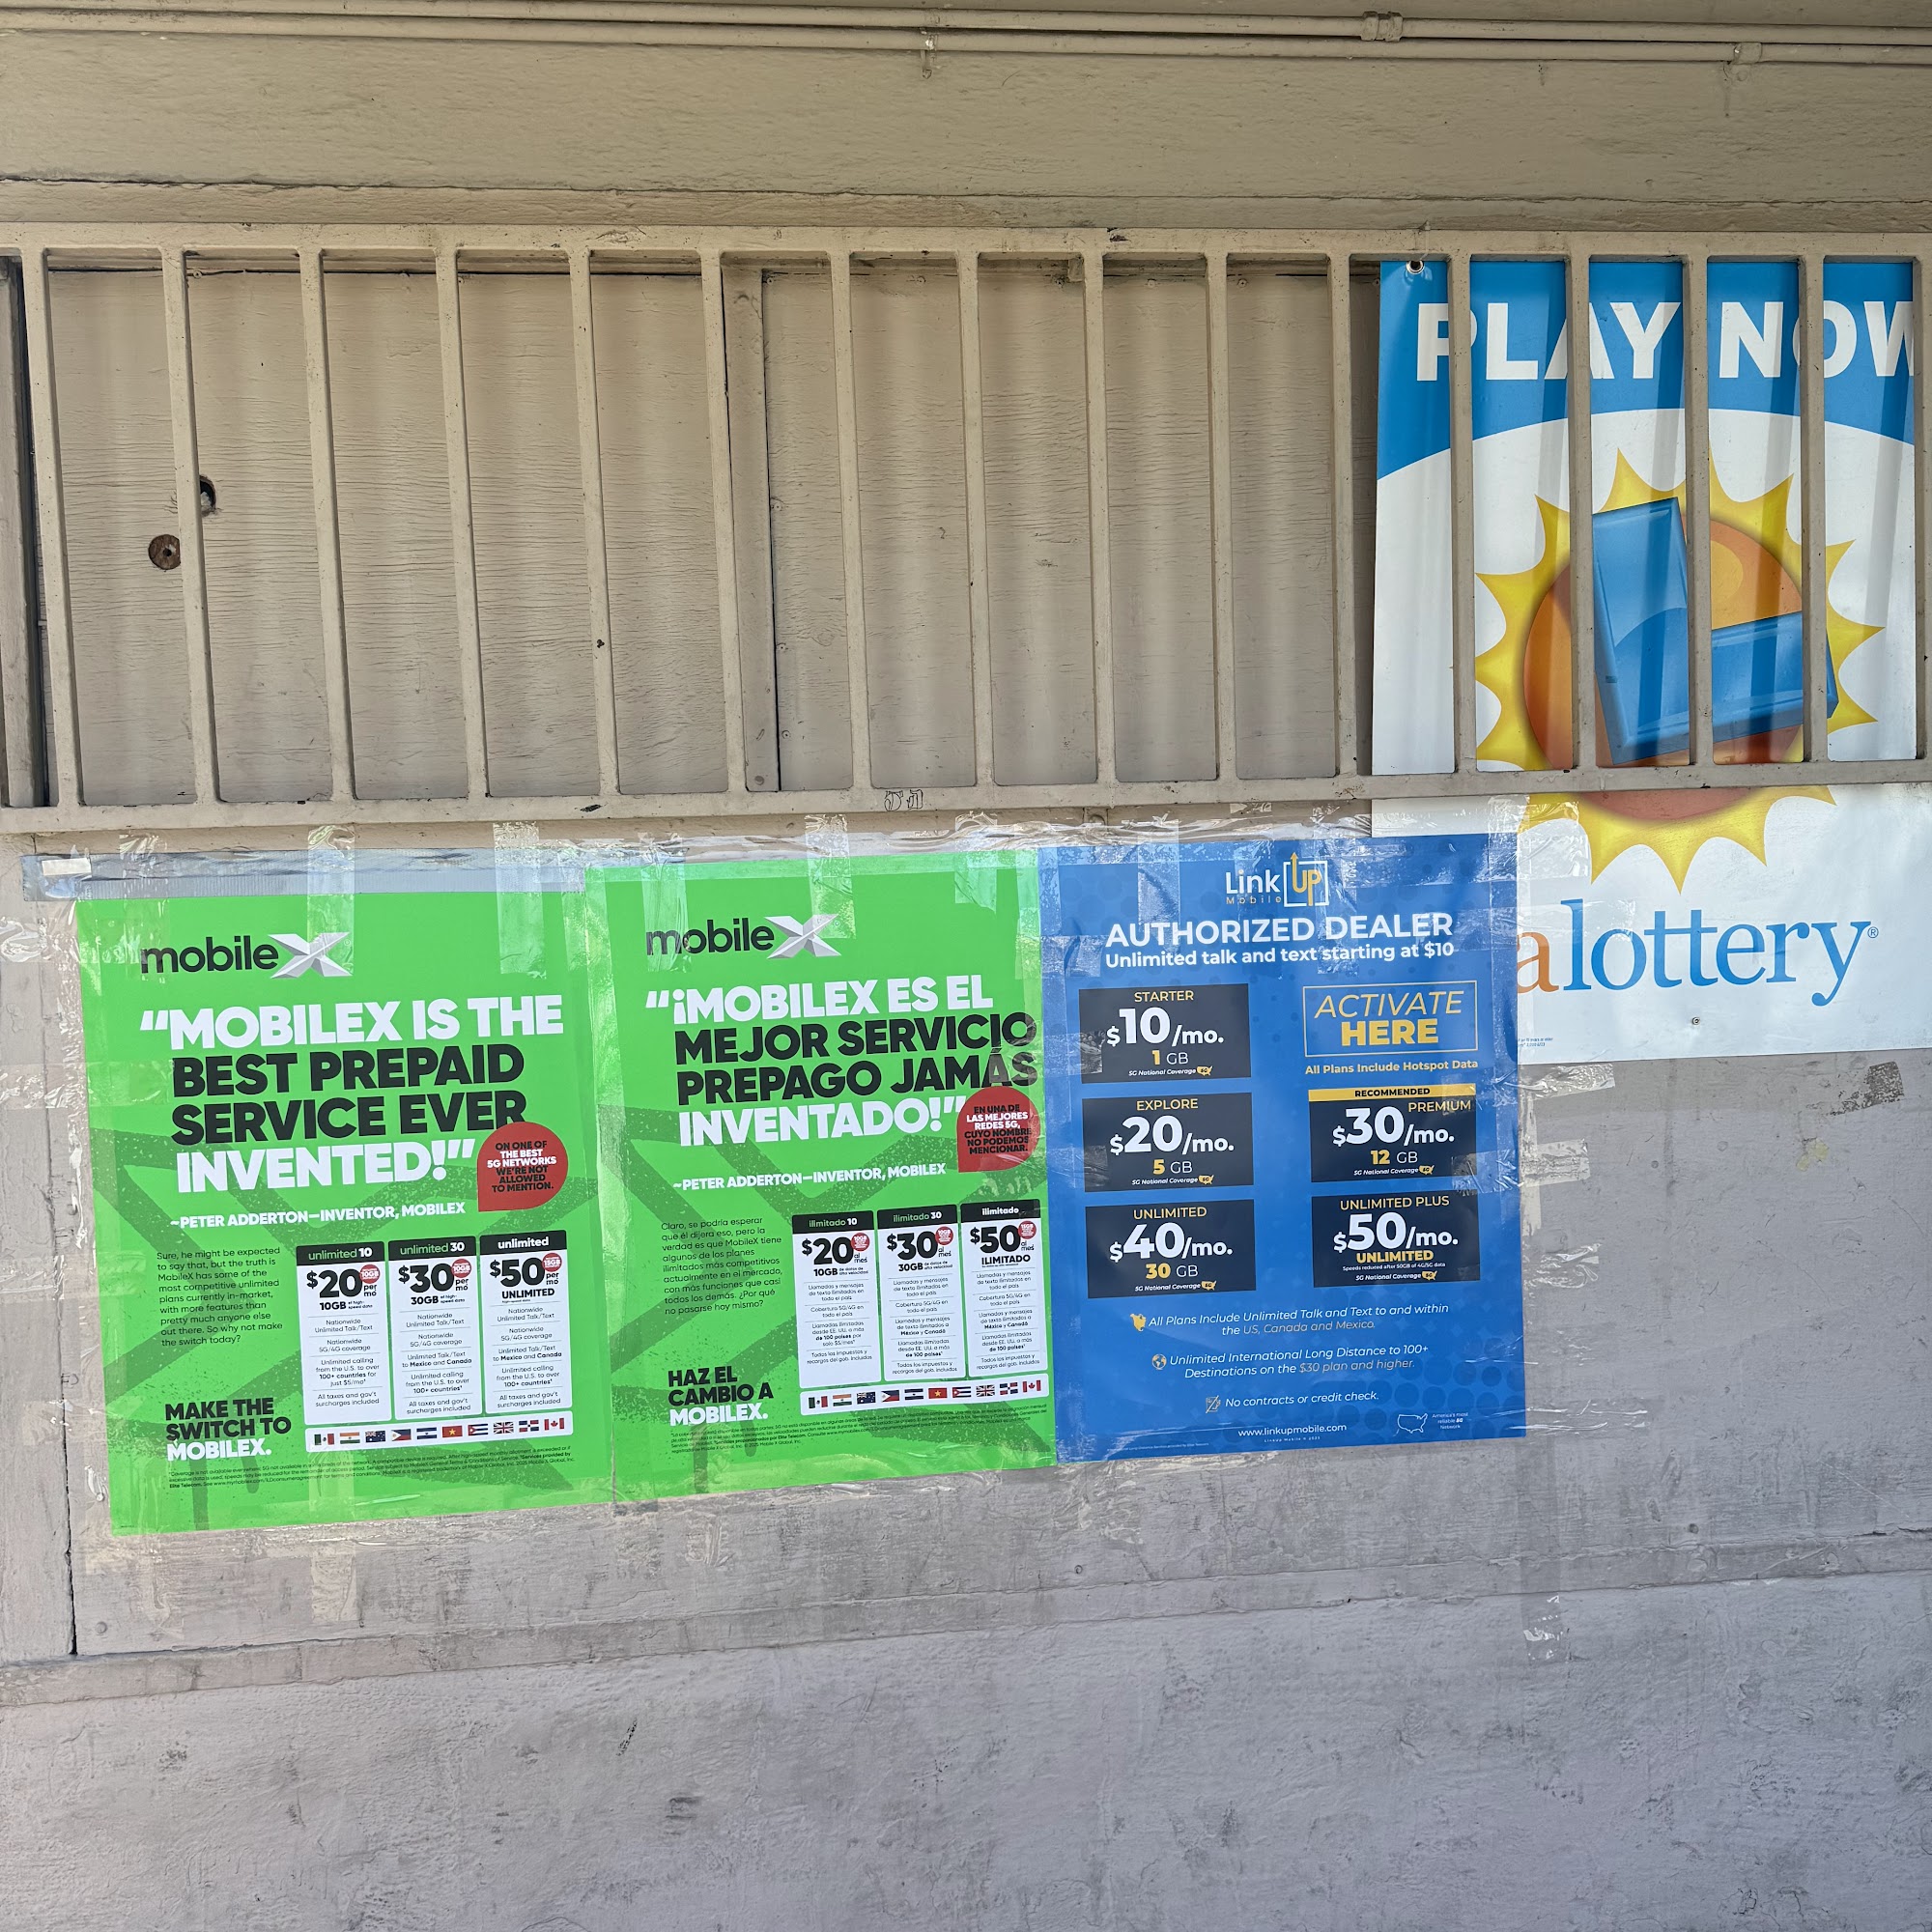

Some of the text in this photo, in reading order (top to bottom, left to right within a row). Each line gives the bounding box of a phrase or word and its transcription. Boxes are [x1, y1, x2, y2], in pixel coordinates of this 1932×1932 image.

[1416, 300, 1681, 382] PLAY
[1226, 869, 1281, 895] Link
[1226, 896, 1282, 905] Mobile
[1106, 912, 1453, 948] AUTHORIZED DEALER
[1106, 941, 1454, 968] Unlimited talk and text starting at $10
[887, 976, 938, 1013] ES
[947, 974, 993, 1010] EL
[1134, 990, 1194, 1002] STARTER
[1314, 990, 1464, 1018] ACTIVATE
[413, 999, 460, 1039] IS
[467, 994, 563, 1036] THE
[674, 1011, 1037, 1065] MEJOR SERVICIO
[1341, 1018, 1438, 1046] HERE
[1151, 1050, 1188, 1065] 1 GB
[171, 1043, 525, 1098] BEST PREPAID
[1305, 1060, 1478, 1074] All Plans Include Hotspot Data
[677, 1047, 1039, 1105] PREPAGO JAMÁS
[1354, 1088, 1430, 1097] RECOMMENDED
[1136, 1098, 1198, 1111] EXPLORE
[1408, 1100, 1471, 1112] PREMIUM
[171, 1090, 526, 1146] SERVICE EVER
[985, 1112, 1028, 1122] MEJORES
[975, 1122, 1004, 1130] REDES
[992, 1128, 1031, 1137] NOMBRE
[983, 1136, 1029, 1145] PODEMOS
[970, 1145, 1028, 1154] MENCIONAR.
[487, 1156, 556, 1168] 5G NETWORKS
[1371, 1150, 1418, 1165] 12 GB
[888, 1163, 946, 1178] MOBILEX
[1153, 1159, 1192, 1175] 5 GB
[499, 1175, 545, 1183] ALLOWED
[507, 1182, 554, 1191] MENTION.
[402, 1202, 466, 1217] MOBILEX
[1340, 1196, 1450, 1210] UNLIMITED PLUS
[1133, 1208, 1207, 1219] UNLIMITED
[497, 1236, 549, 1250] unlimited
[887, 1231, 938, 1261] $30
[970, 1225, 1021, 1253] $50
[309, 1248, 372, 1260] unlimited 10
[400, 1242, 465, 1255] unlimited 30
[802, 1236, 854, 1264] $20
[981, 1255, 1031, 1265] ILIMITADO
[1356, 1250, 1434, 1264] UNLIMITED
[490, 1257, 545, 1287] $50
[898, 1263, 923, 1272] 30GB
[1146, 1264, 1198, 1279] 30 GB
[306, 1269, 363, 1298] $20
[398, 1264, 454, 1293] $30
[411, 1296, 439, 1305] 30GB
[501, 1289, 554, 1299] UNLIMITED
[320, 1301, 346, 1310] 10GB
[1148, 1303, 1449, 1327] All Plans Include Unlimited Talk and Text to and within
[1222, 1320, 1376, 1336] the US, Canada and Mexico.
[668, 1366, 737, 1387] HAZ EL
[668, 1382, 774, 1406] CAMBIO A
[1225, 1391, 1379, 1407] No contracts or credit check.
[165, 1398, 273, 1421] MAKE THE
[669, 1403, 768, 1426] MOBILEX.
[166, 1416, 291, 1441] SWITCH TO
[1237, 1423, 1347, 1436] www.linkupmobile.com
[167, 1437, 271, 1462] MOBILEX.
